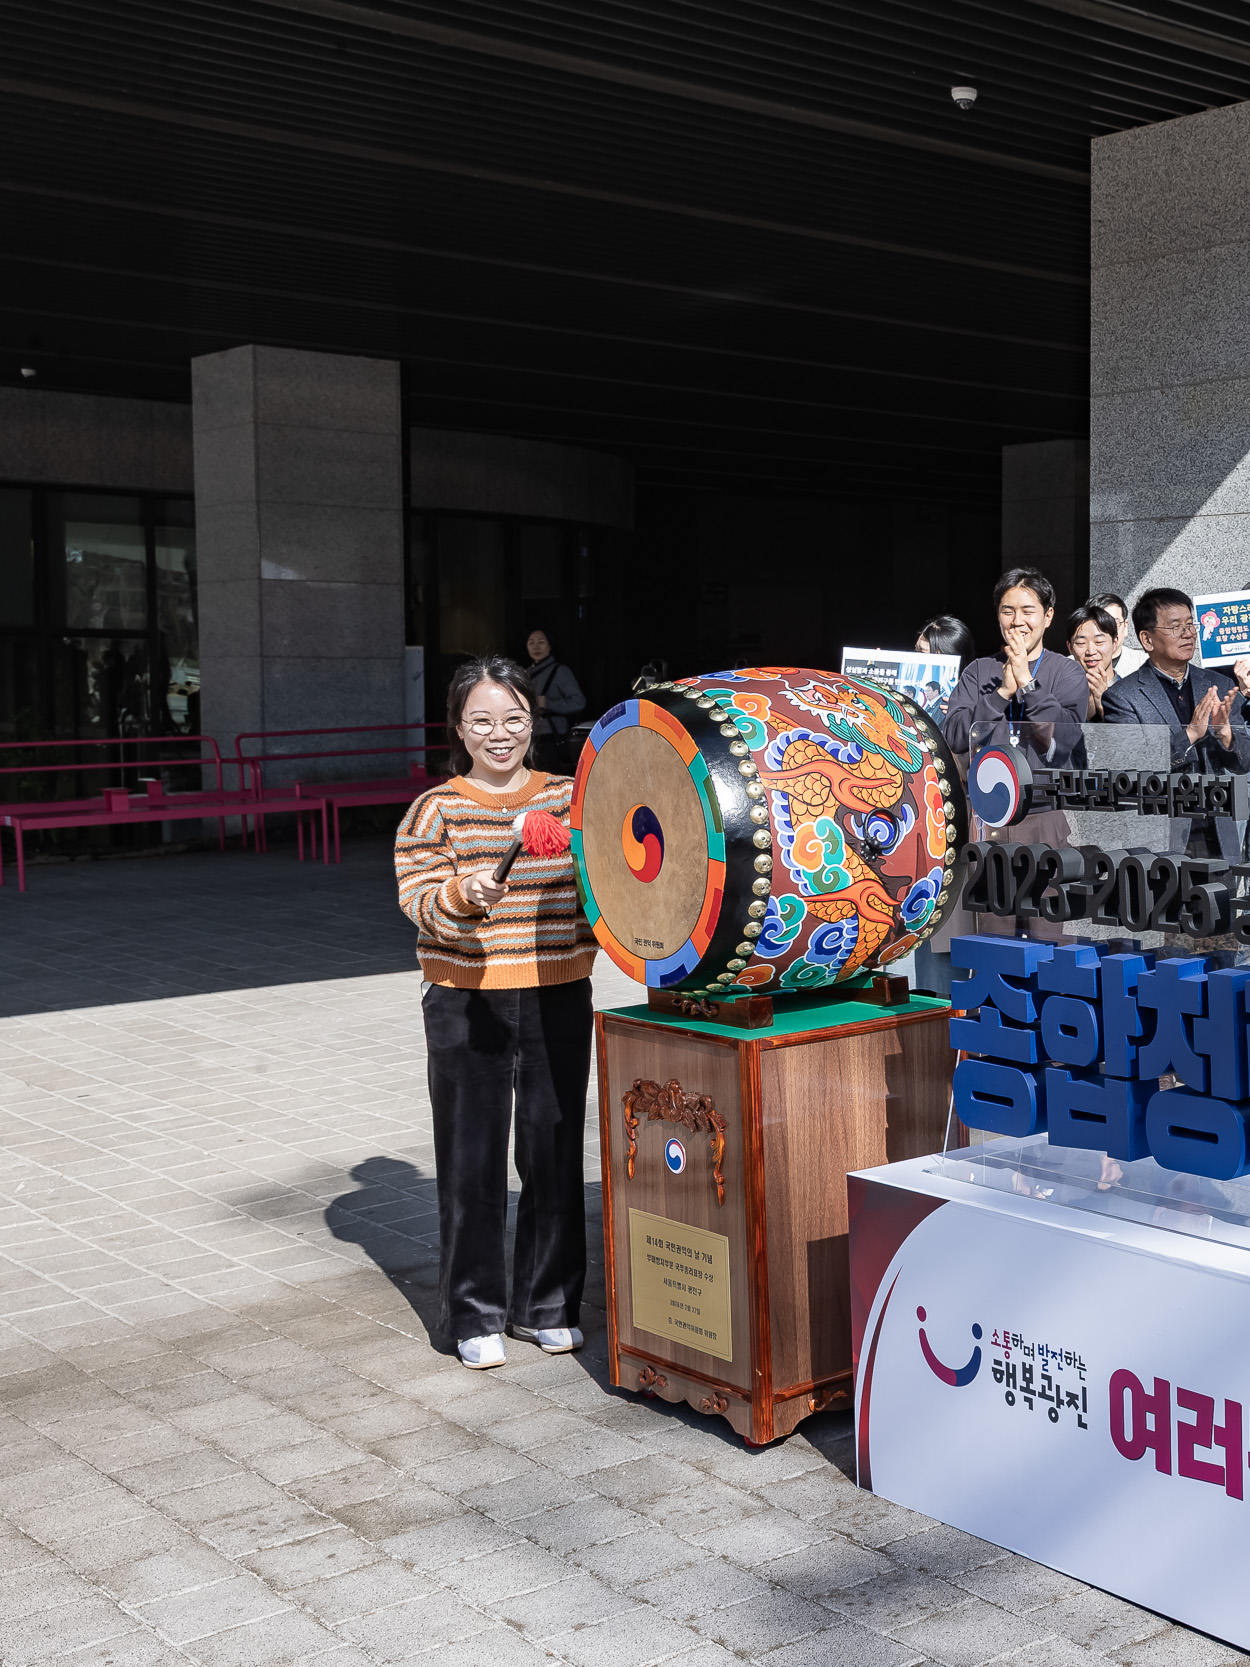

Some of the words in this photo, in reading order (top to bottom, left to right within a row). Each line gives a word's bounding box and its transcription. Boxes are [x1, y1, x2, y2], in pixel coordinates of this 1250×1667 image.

[1218, 625, 1249, 635] 종합청렴도
[1221, 616, 1237, 625] 우리
[1215, 635, 1228, 643] 표창
[1229, 632, 1248, 641] 수상을
[1032, 768, 1247, 821] 국민권익위원회
[960, 841, 1230, 938] 2023-2025
[646, 1235, 664, 1249] 제14회
[665, 1241, 692, 1258] 국민권익의
[694, 1250, 700, 1260] 날
[702, 1252, 713, 1264] 기념
[663, 1277, 687, 1292] 서울특별시
[687, 1285, 702, 1297] 광진구
[704, 1272, 714, 1283] 수상
[990, 1329, 1035, 1360] 소통하며
[1037, 1343, 1087, 1381] 발전하는
[991, 1359, 1088, 1430] 행복광진
